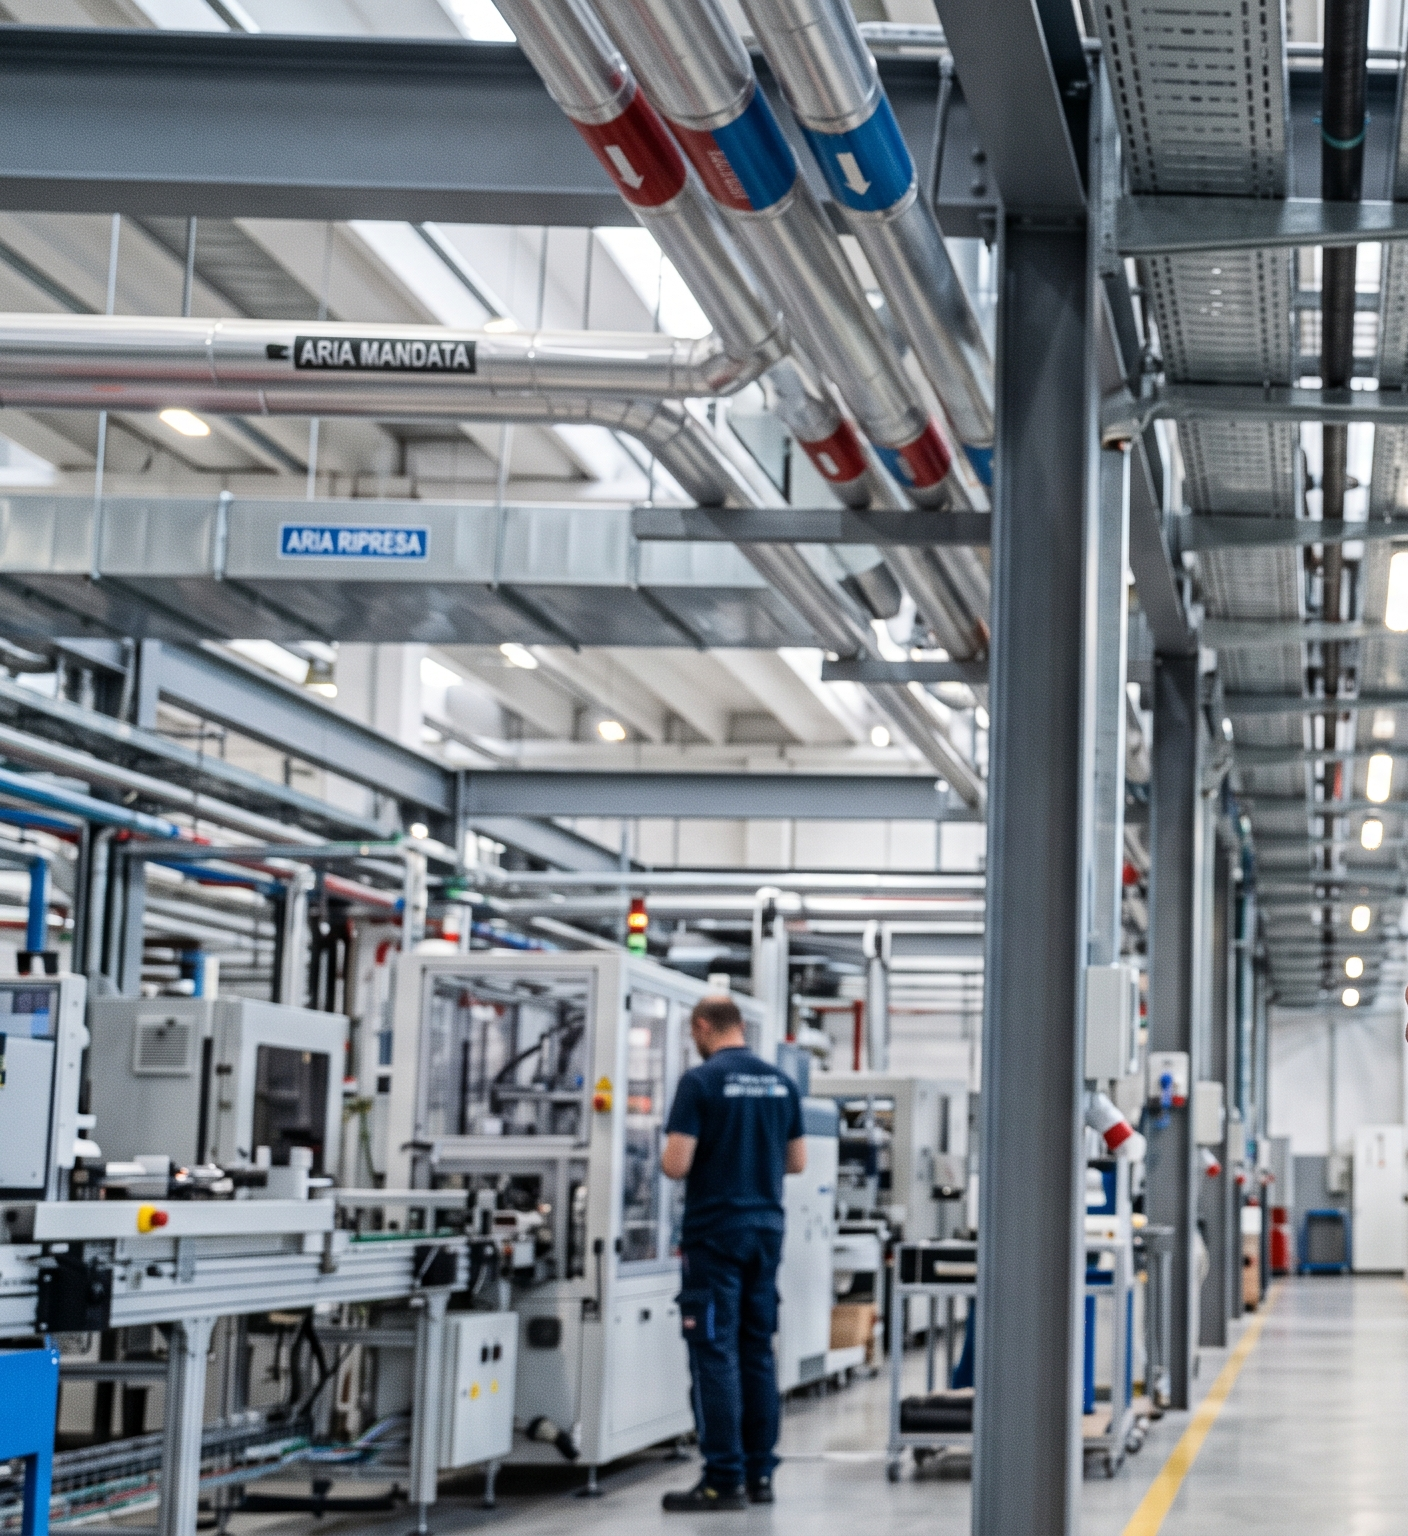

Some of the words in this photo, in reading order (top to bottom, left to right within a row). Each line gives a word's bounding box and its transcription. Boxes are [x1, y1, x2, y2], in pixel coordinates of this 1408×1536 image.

[300, 339, 357, 367] ARIA
[359, 340, 470, 369] MANDATA
[286, 529, 335, 554] ARIA
[337, 530, 423, 556] RIPRESA
